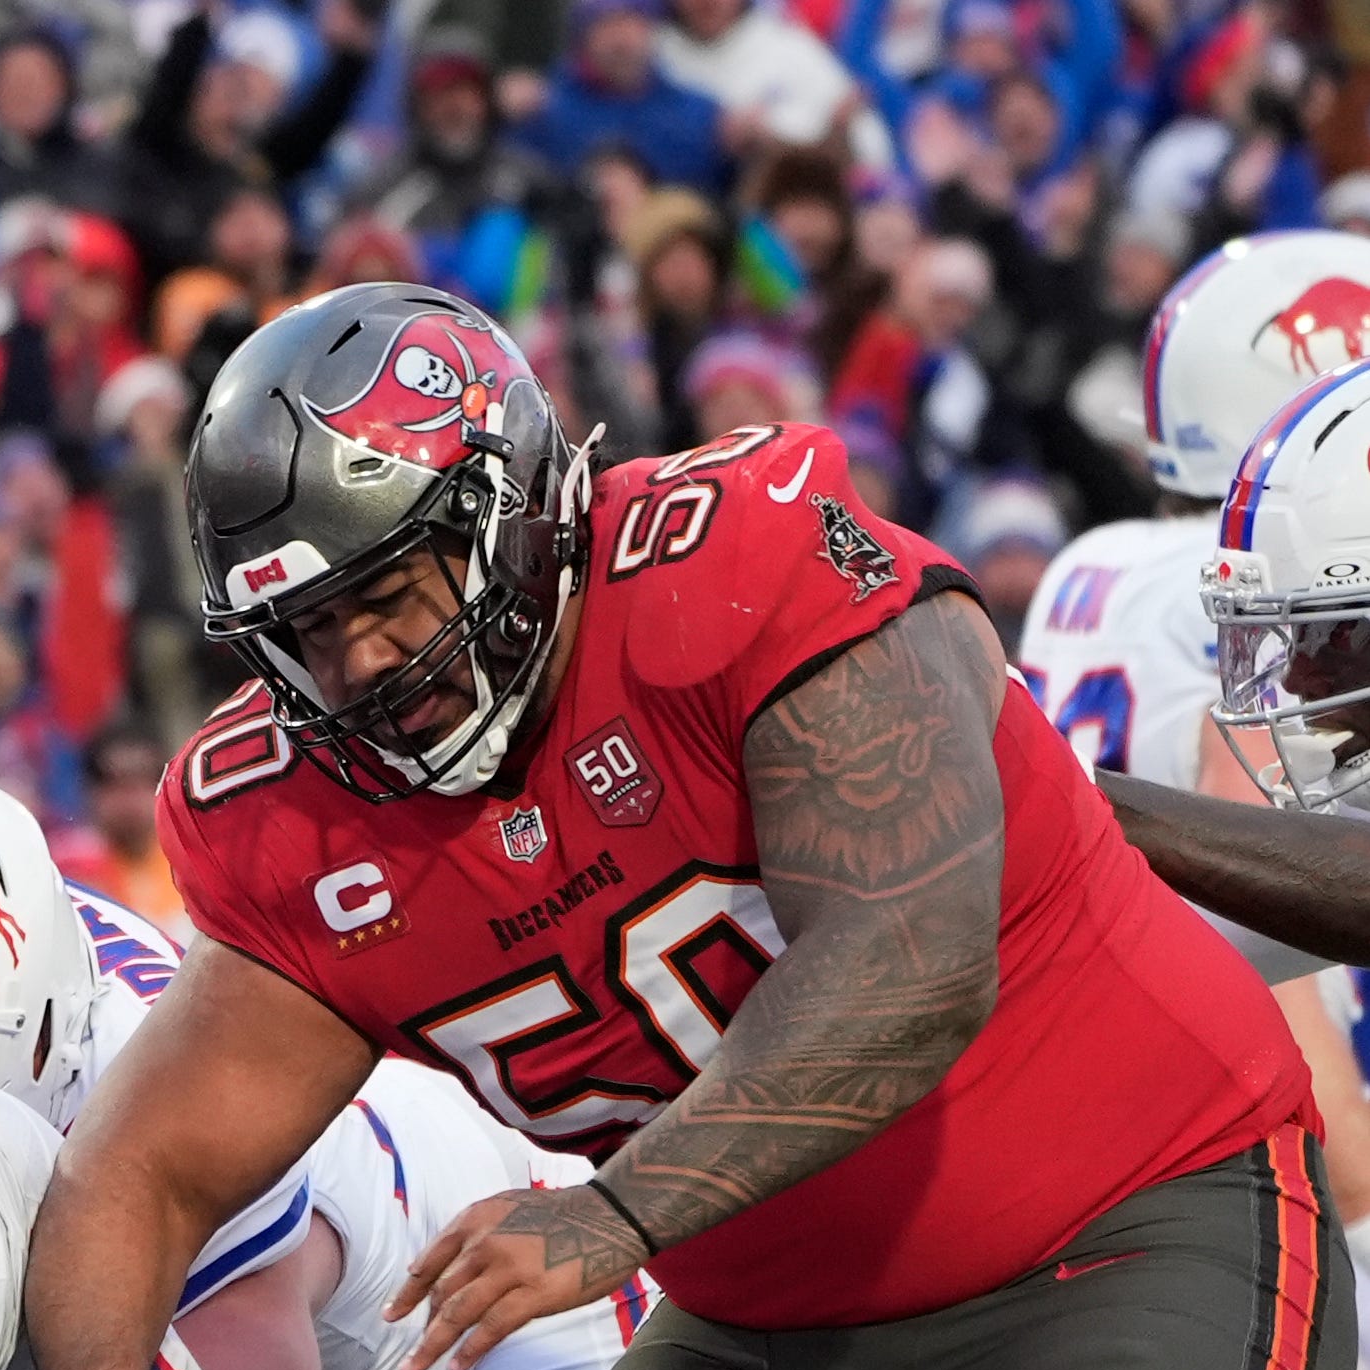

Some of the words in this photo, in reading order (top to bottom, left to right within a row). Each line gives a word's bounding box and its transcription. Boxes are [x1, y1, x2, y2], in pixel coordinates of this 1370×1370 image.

[575, 735, 638, 797] 50
[508, 828, 540, 855] NFL
[313, 861, 393, 931] C
[401, 860, 784, 1165] 50
